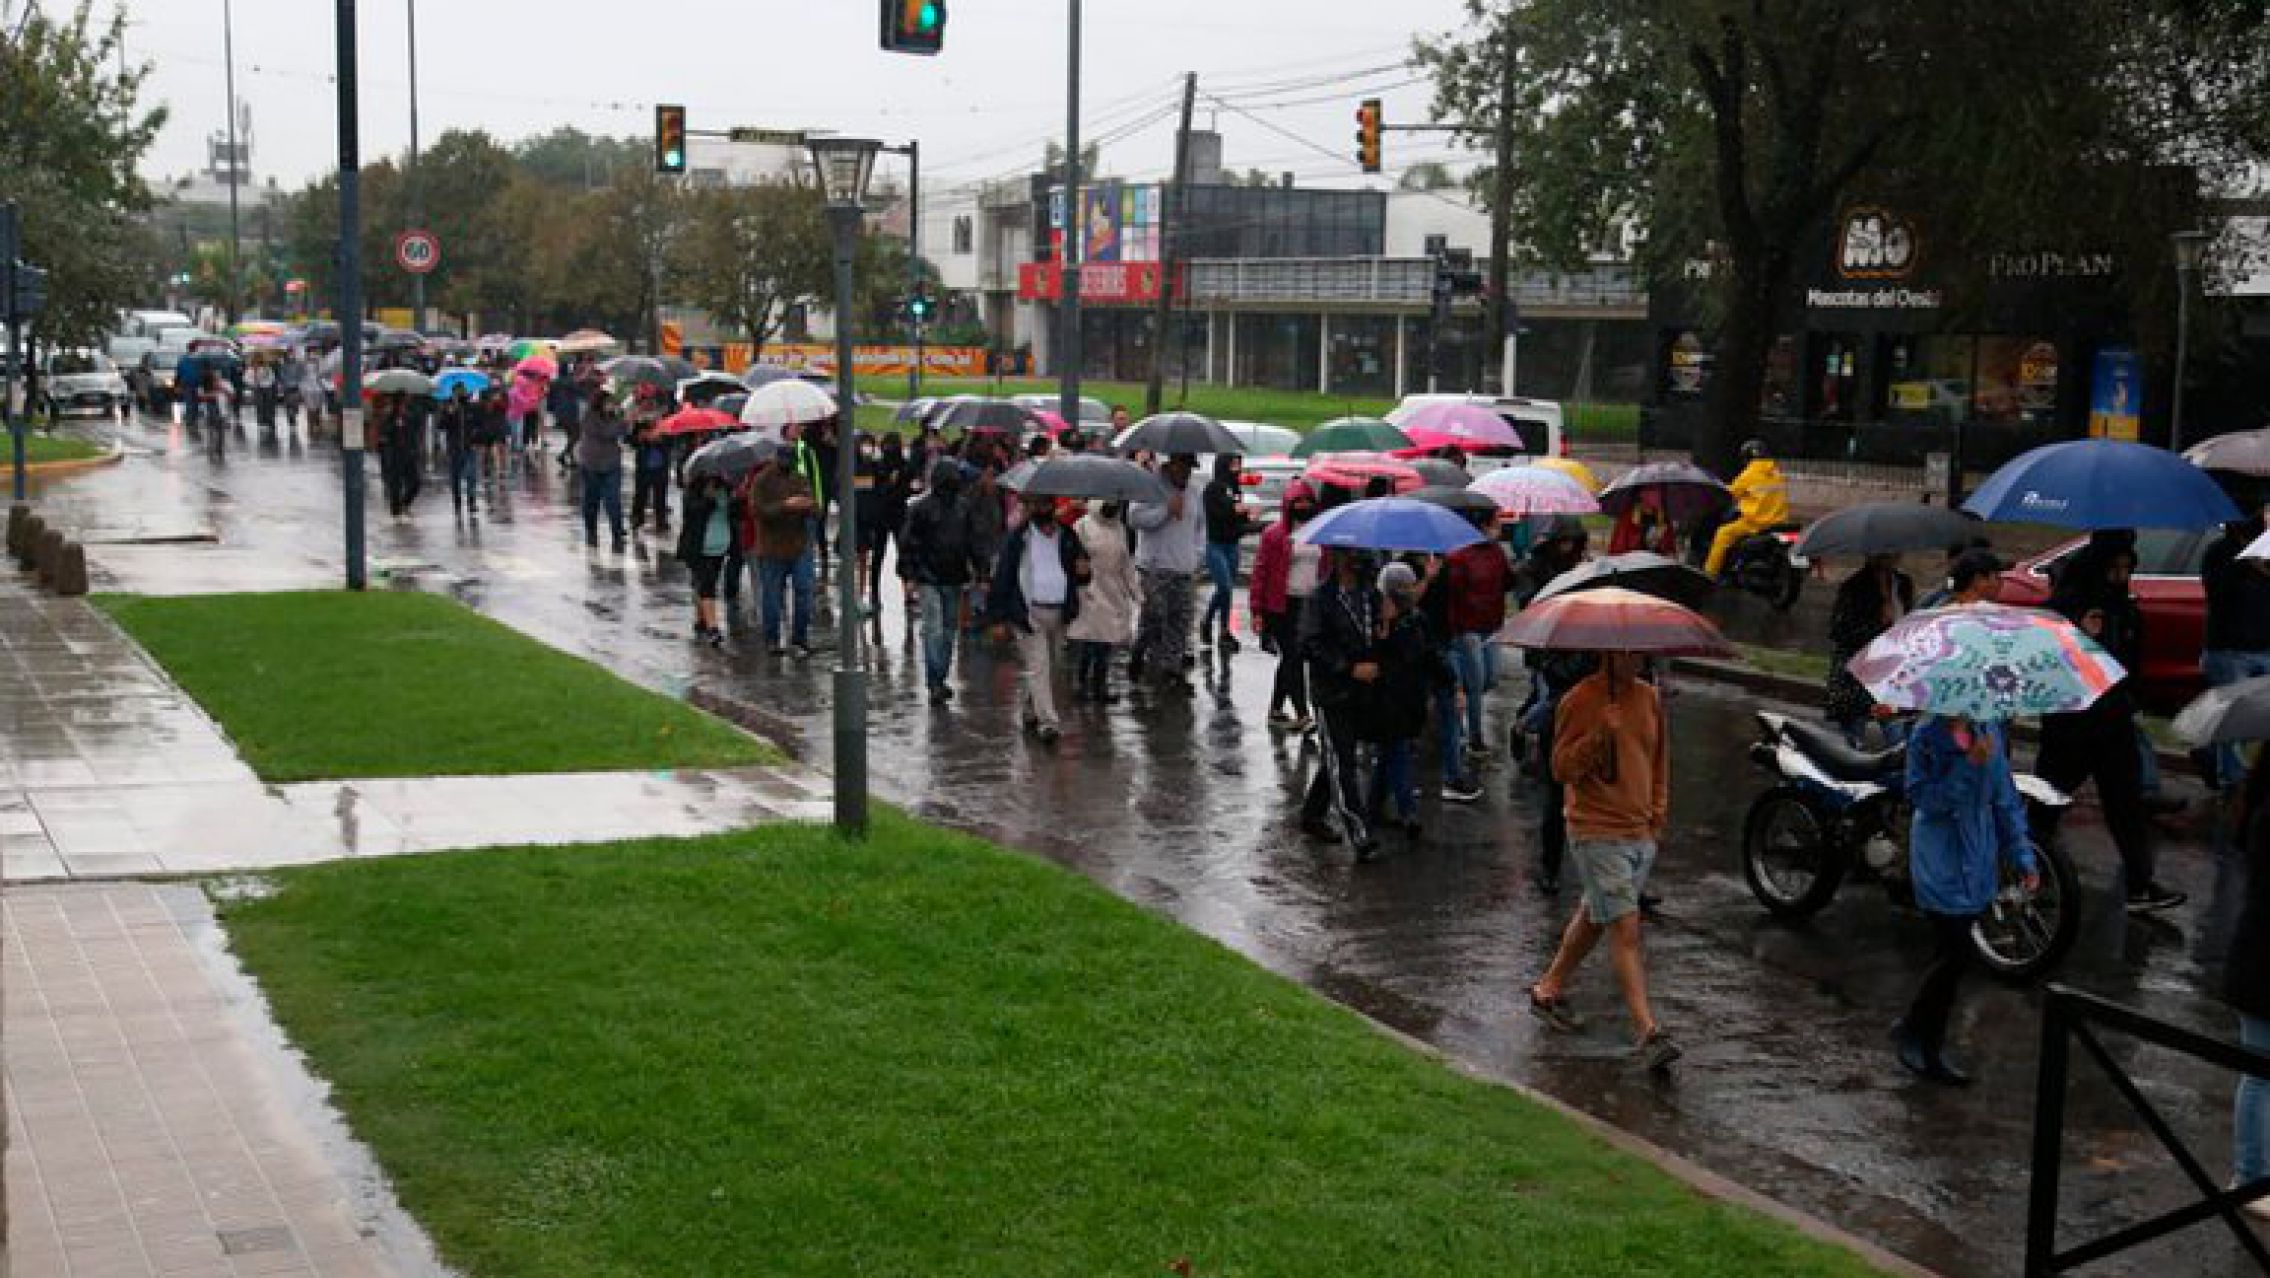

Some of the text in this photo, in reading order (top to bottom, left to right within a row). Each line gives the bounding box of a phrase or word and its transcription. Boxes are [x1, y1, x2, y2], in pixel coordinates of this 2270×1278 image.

[404, 241, 430, 261] 60
[1807, 286, 1870, 308] Mascotas
[1873, 286, 1896, 308] del
